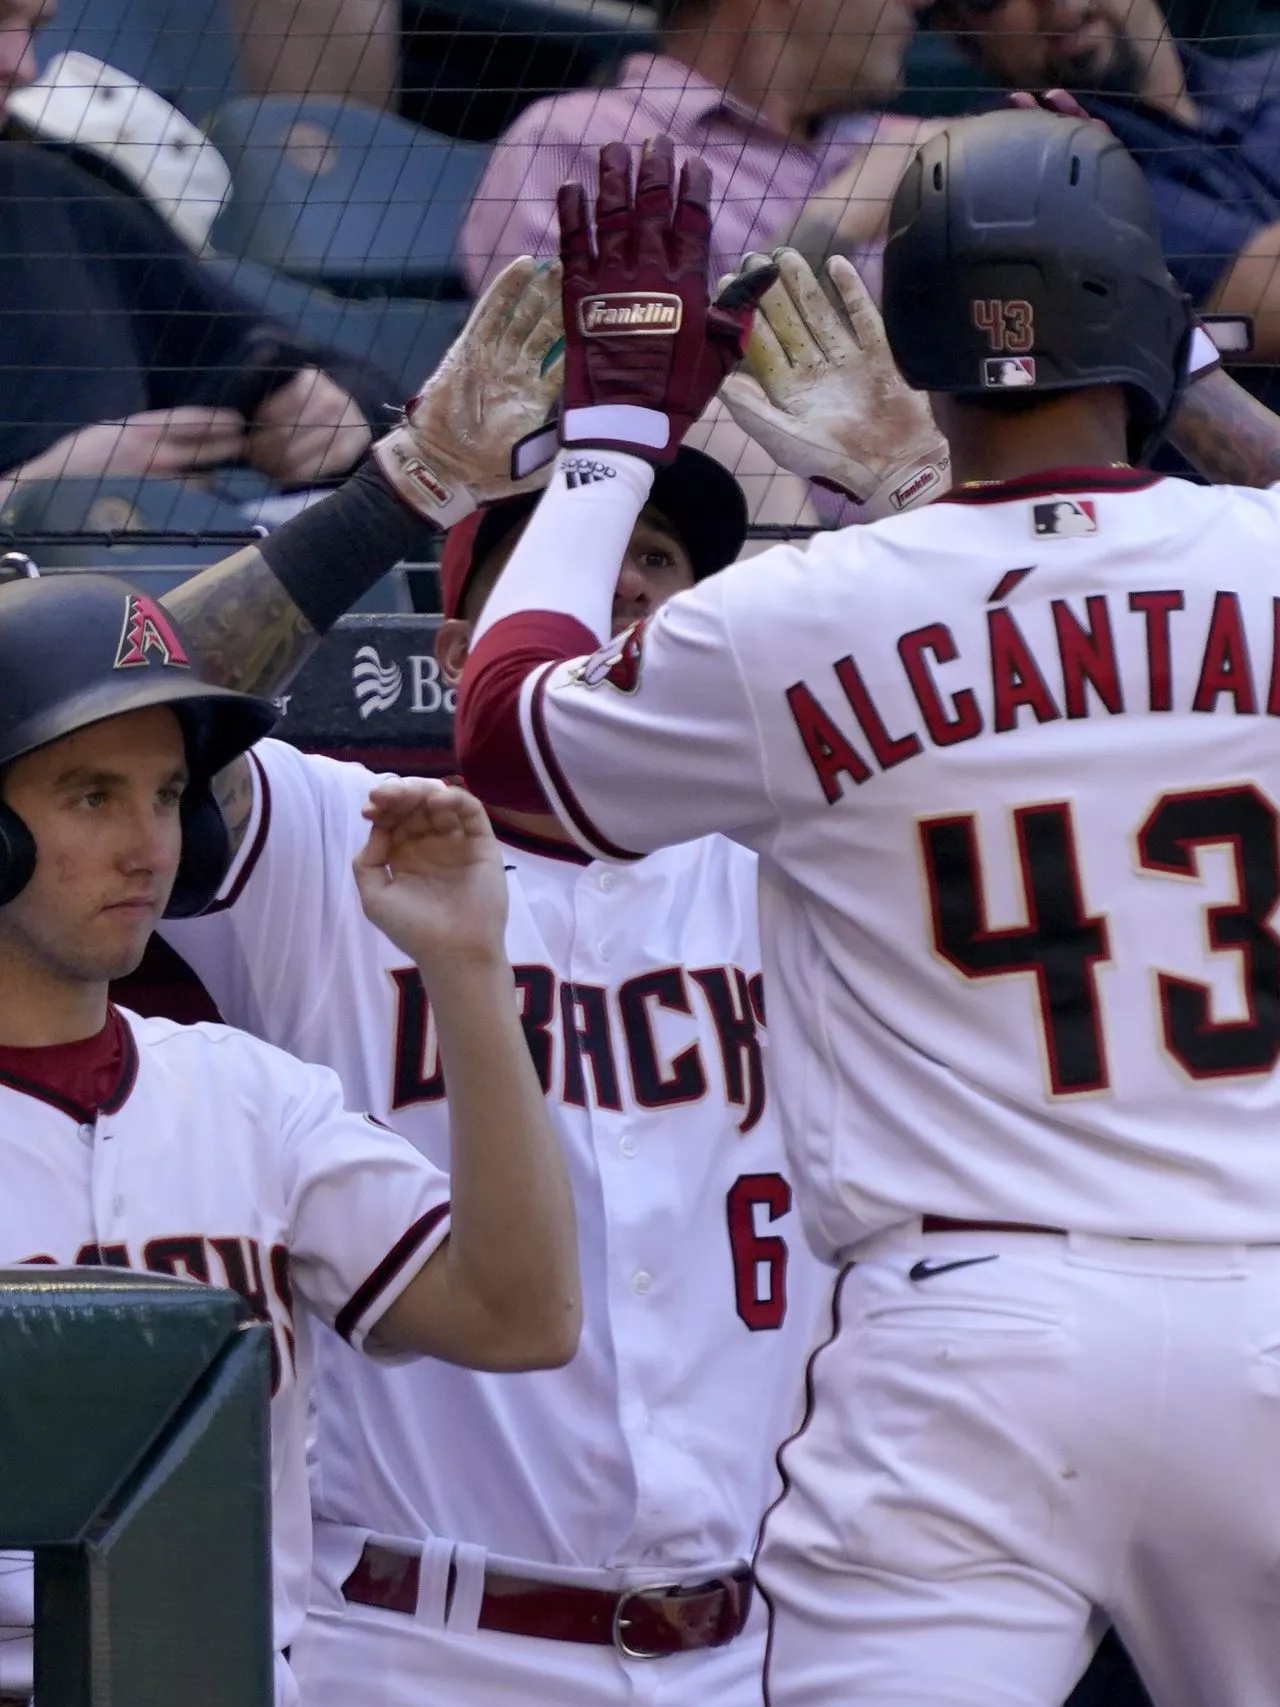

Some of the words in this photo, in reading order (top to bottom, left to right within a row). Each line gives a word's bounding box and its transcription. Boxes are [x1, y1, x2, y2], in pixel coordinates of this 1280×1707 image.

[586, 301, 676, 329] Franklin
[973, 299, 1034, 351] 43
[727, 1172, 792, 1332] 6
